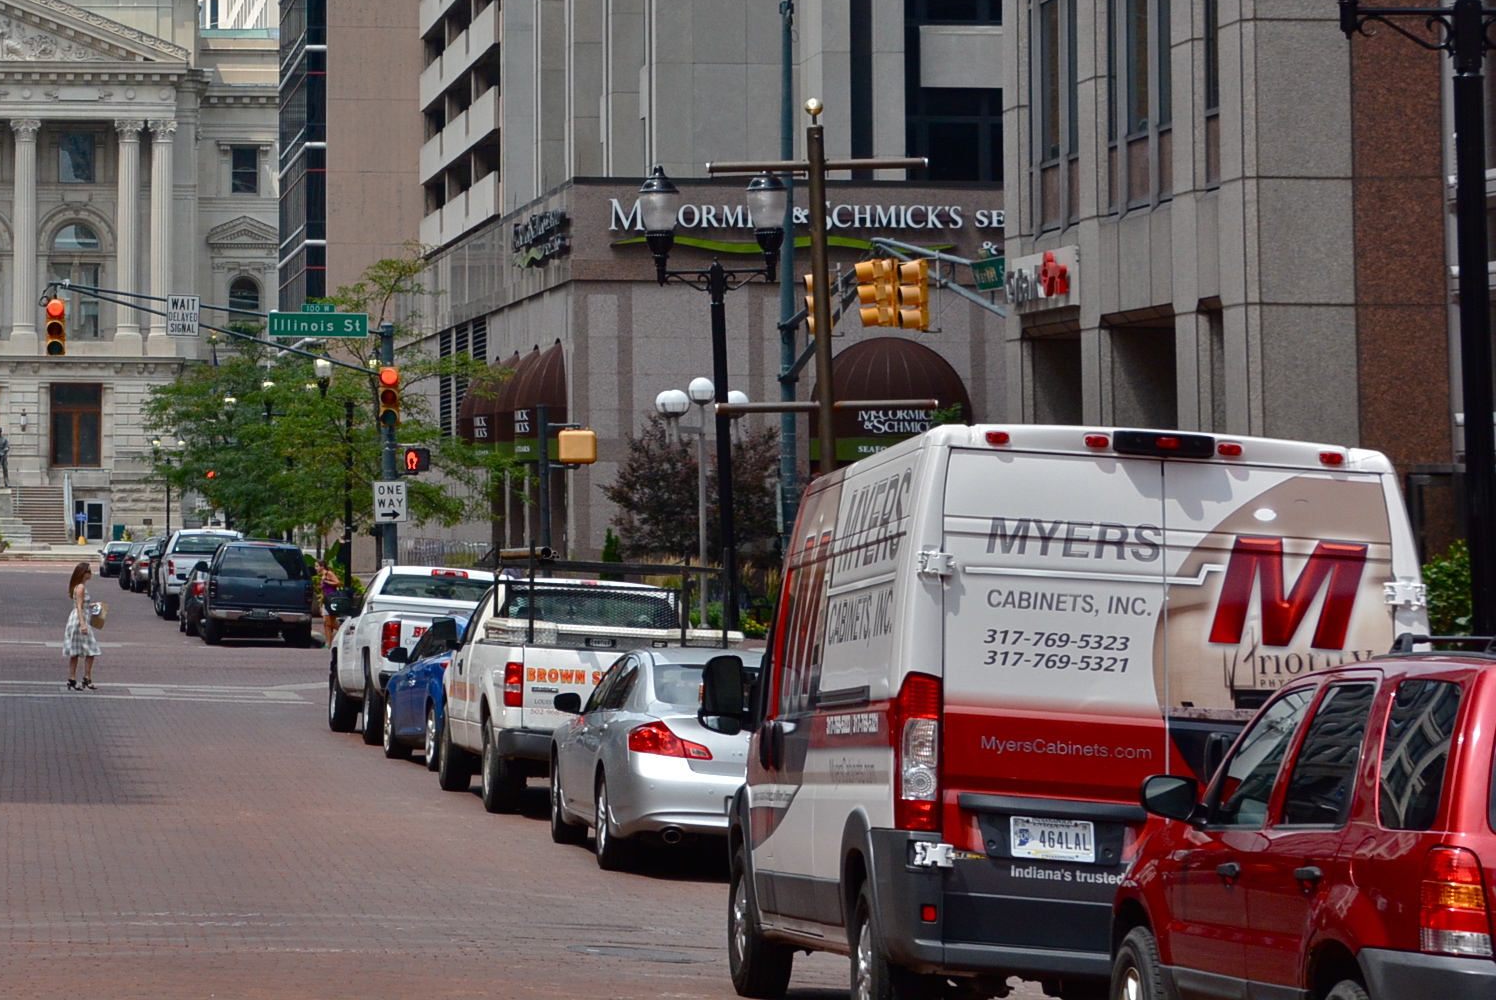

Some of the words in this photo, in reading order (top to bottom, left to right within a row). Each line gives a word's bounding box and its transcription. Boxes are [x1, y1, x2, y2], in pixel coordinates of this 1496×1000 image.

[792, 206, 809, 224] &
[974, 210, 1004, 228] SE
[171, 298, 197, 311] WAIT
[168, 312, 198, 322] DELAYED
[170, 322, 196, 333] SIGNAL
[273, 319, 334, 332] Illinois
[343, 319, 361, 332] St
[377, 485, 402, 495] ONE
[377, 498, 404, 508] WAY
[986, 516, 1163, 562] MYERS
[987, 589, 1100, 617] CABINETS,
[1107, 596, 1152, 616] INC.
[1208, 535, 1369, 650] M
[983, 629, 1131, 652] 317-769-5323
[983, 650, 1130, 673] 317-769-5321
[526, 667, 586, 684] BROWN
[592, 671, 607, 685] S
[981, 736, 1152, 760] MyersCabinets.com
[1039, 829, 1090, 851] 464LAL
[1010, 865, 1072, 881] Indiana's
[1075, 870, 1125, 885] trusted
